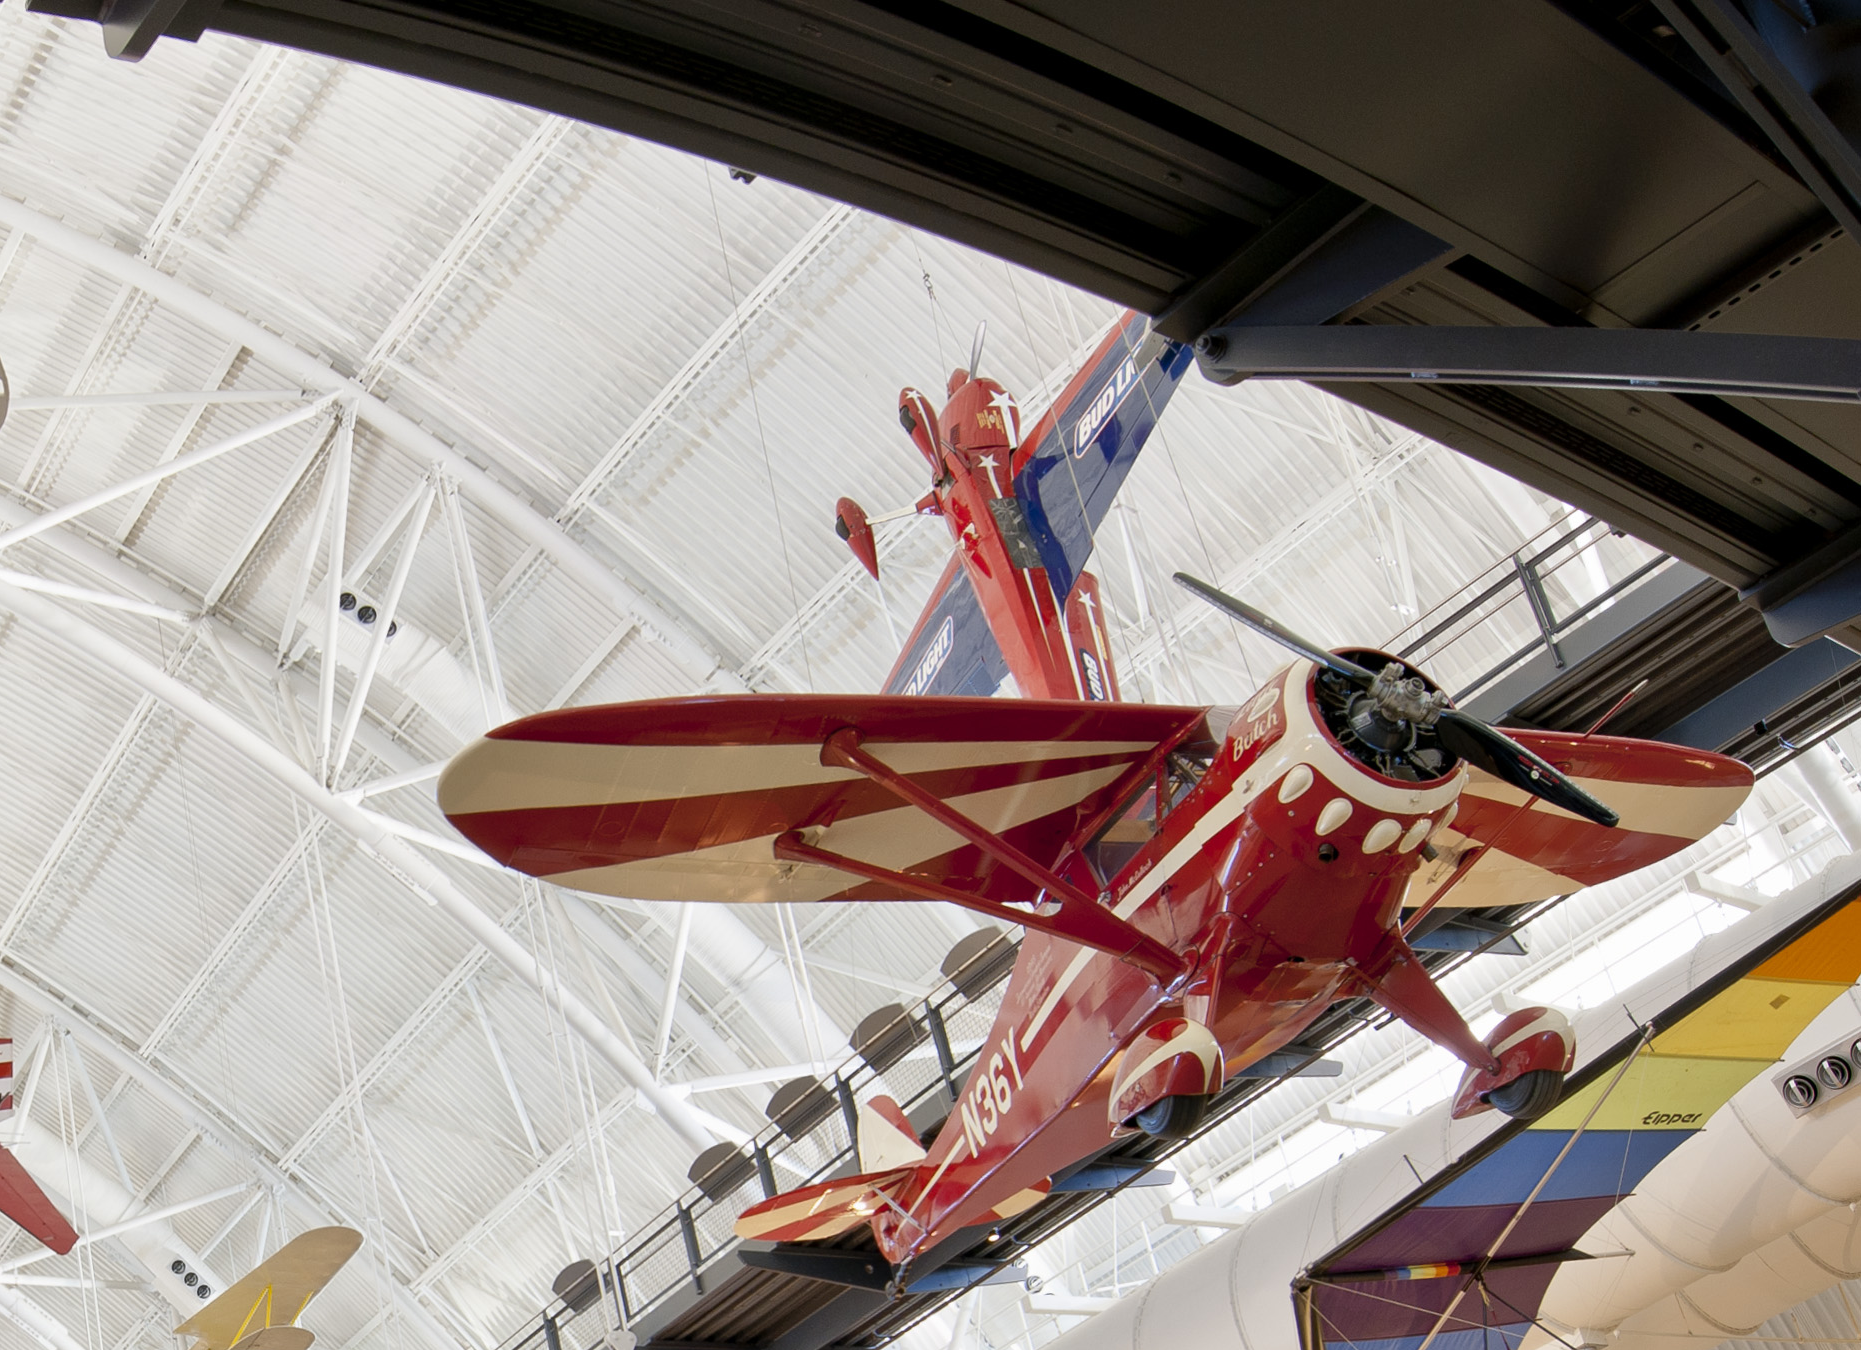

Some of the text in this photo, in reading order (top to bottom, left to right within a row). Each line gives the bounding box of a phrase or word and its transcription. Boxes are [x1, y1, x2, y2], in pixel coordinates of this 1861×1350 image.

[1078, 392, 1117, 450] BUD
[916, 624, 951, 690] LIGHT
[1233, 708, 1279, 762] Butch
[961, 1025, 1024, 1159] N36Y
[1642, 1111, 1703, 1125] Eipper
